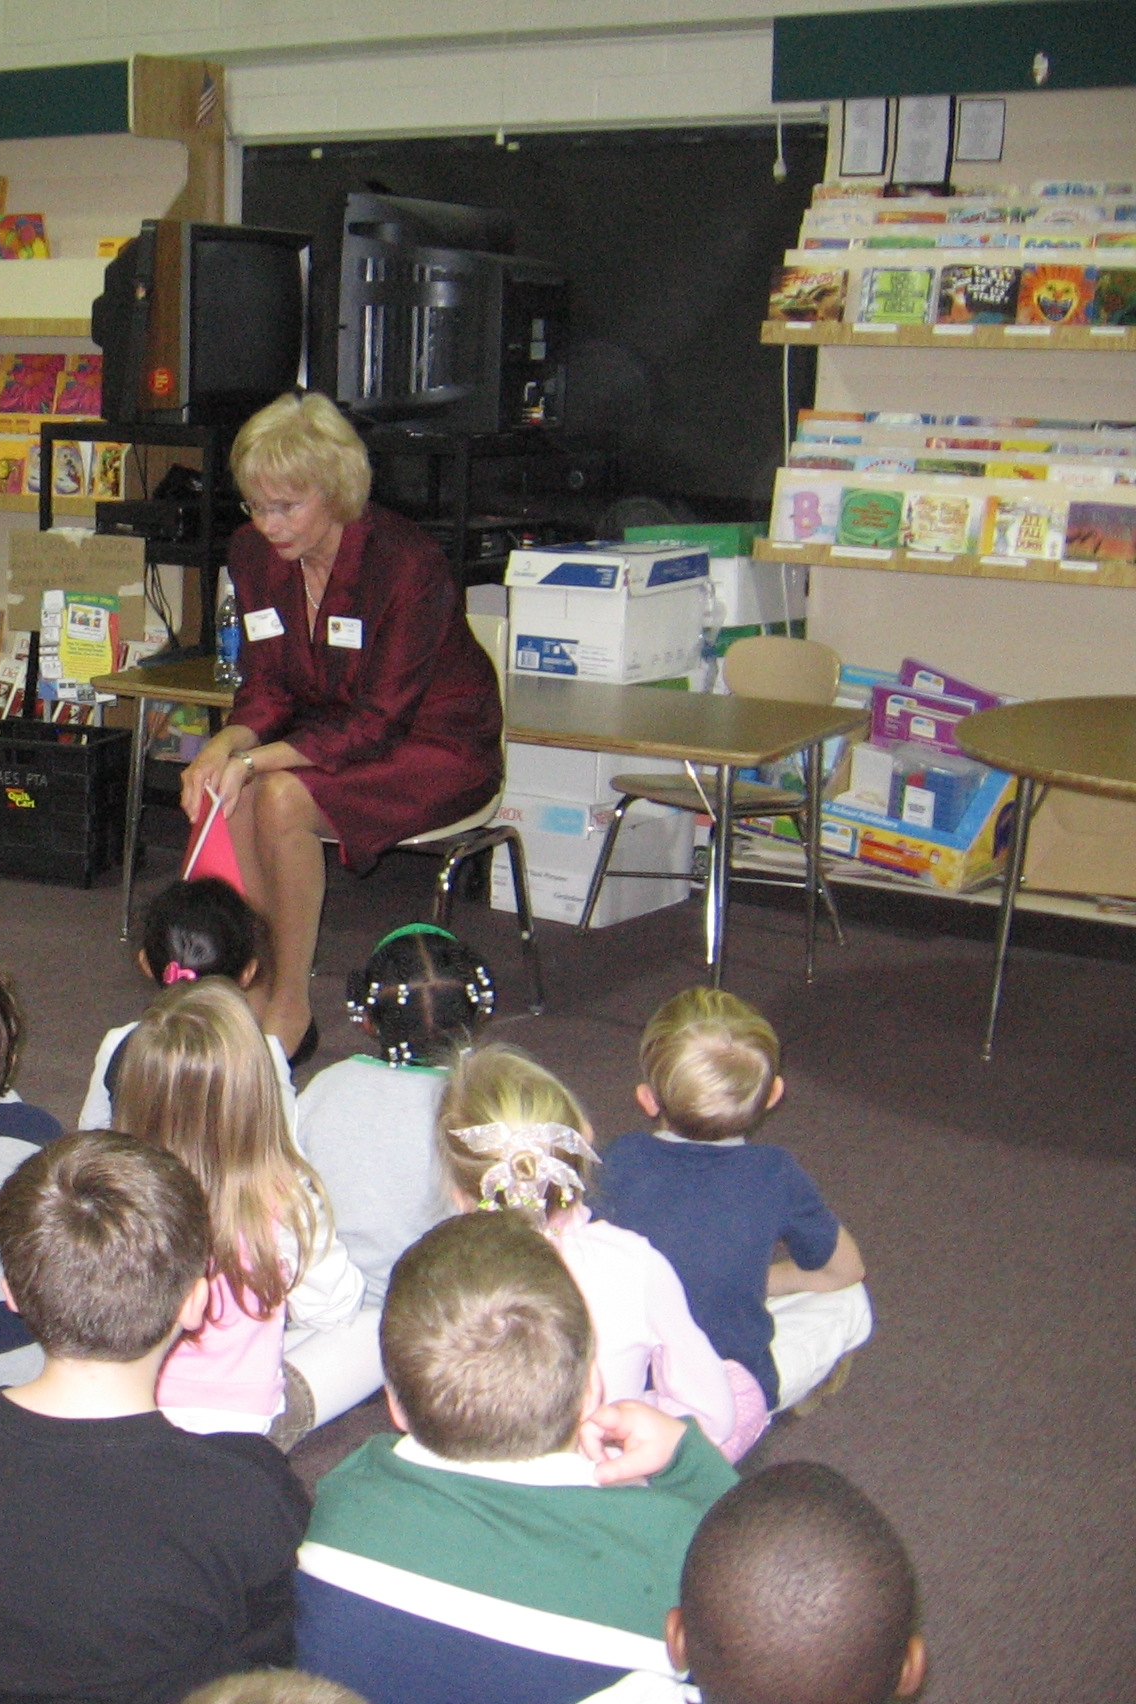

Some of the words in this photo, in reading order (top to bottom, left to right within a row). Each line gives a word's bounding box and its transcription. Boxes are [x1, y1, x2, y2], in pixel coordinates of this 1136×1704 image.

[1022, 515, 1042, 526] ALL
[1020, 527, 1043, 538] FALL
[25, 772, 48, 788] PTA
